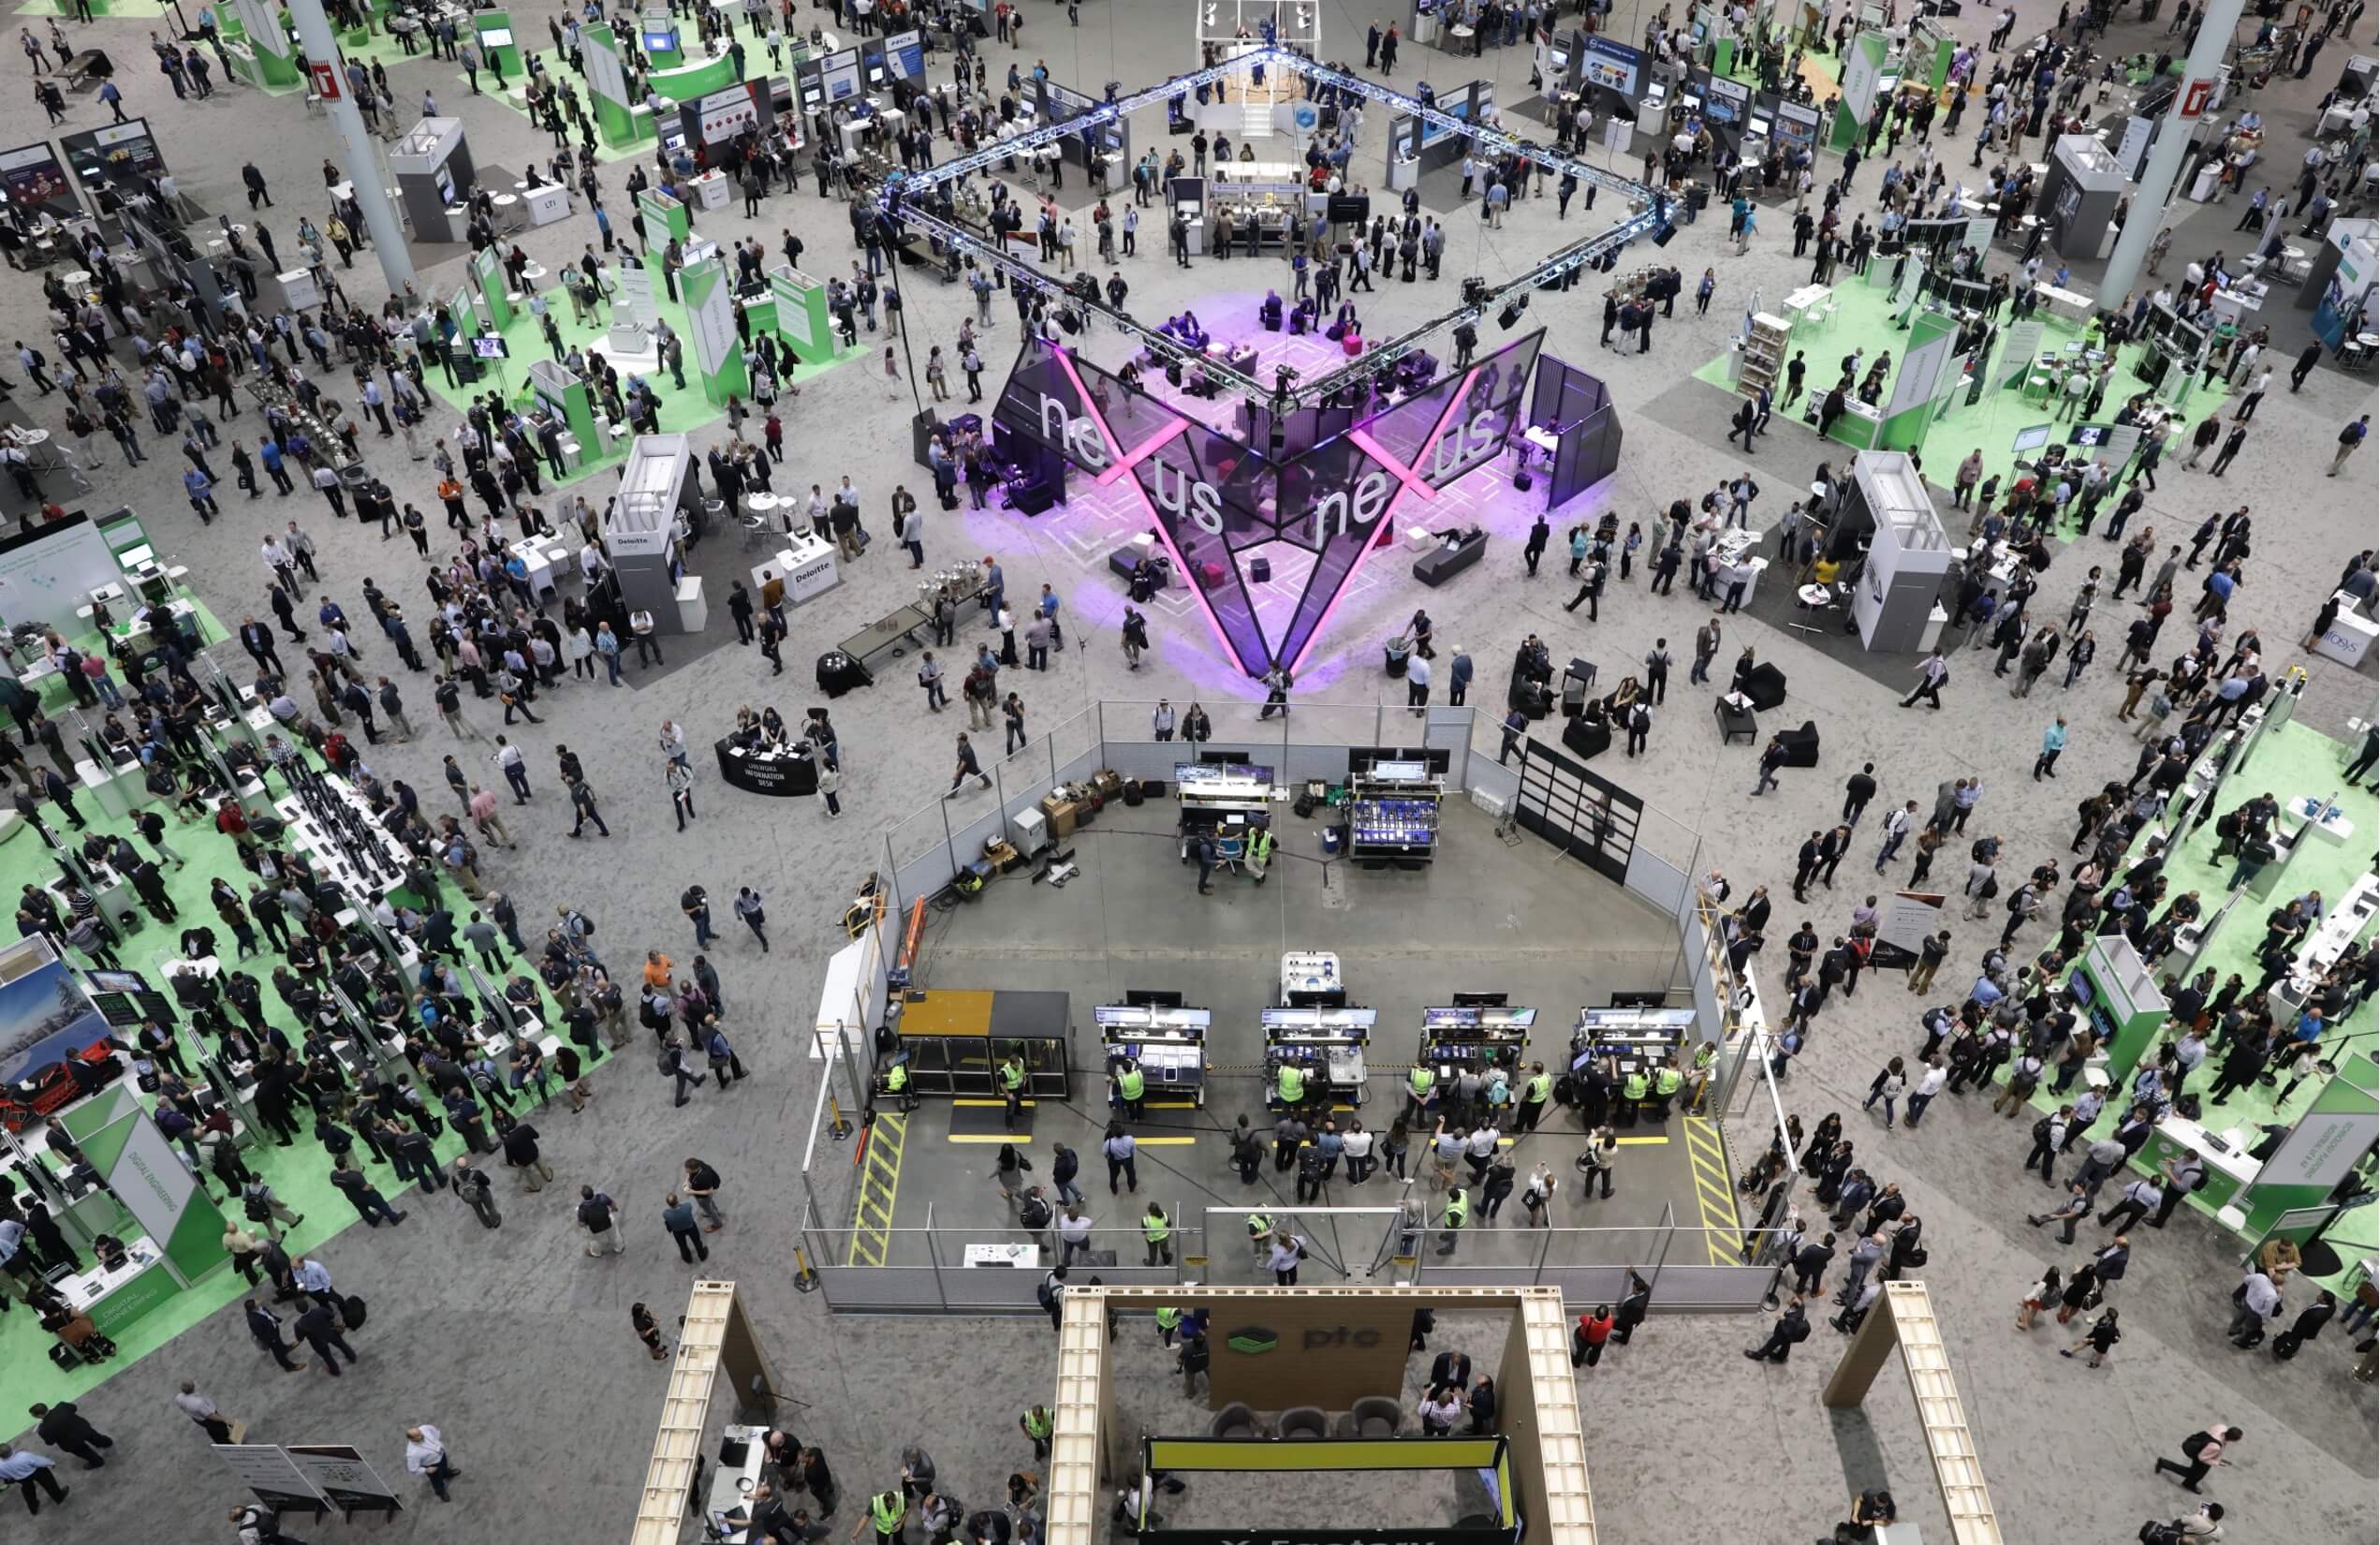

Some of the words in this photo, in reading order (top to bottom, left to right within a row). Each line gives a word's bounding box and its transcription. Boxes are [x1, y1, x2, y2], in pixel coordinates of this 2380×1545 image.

[890, 37, 913, 46] HCL
[2323, 630, 2358, 653] nfosys
[744, 769, 785, 780] INFORMATION
[757, 779, 774, 787] DESK
[127, 1151, 150, 1176] DIGITAL
[143, 1171, 178, 1213] ENGINEERING
[97, 1288, 158, 1330] NGINEERING
[102, 1293, 139, 1318] DIGITAL
[1302, 1324, 1381, 1350] ptc
